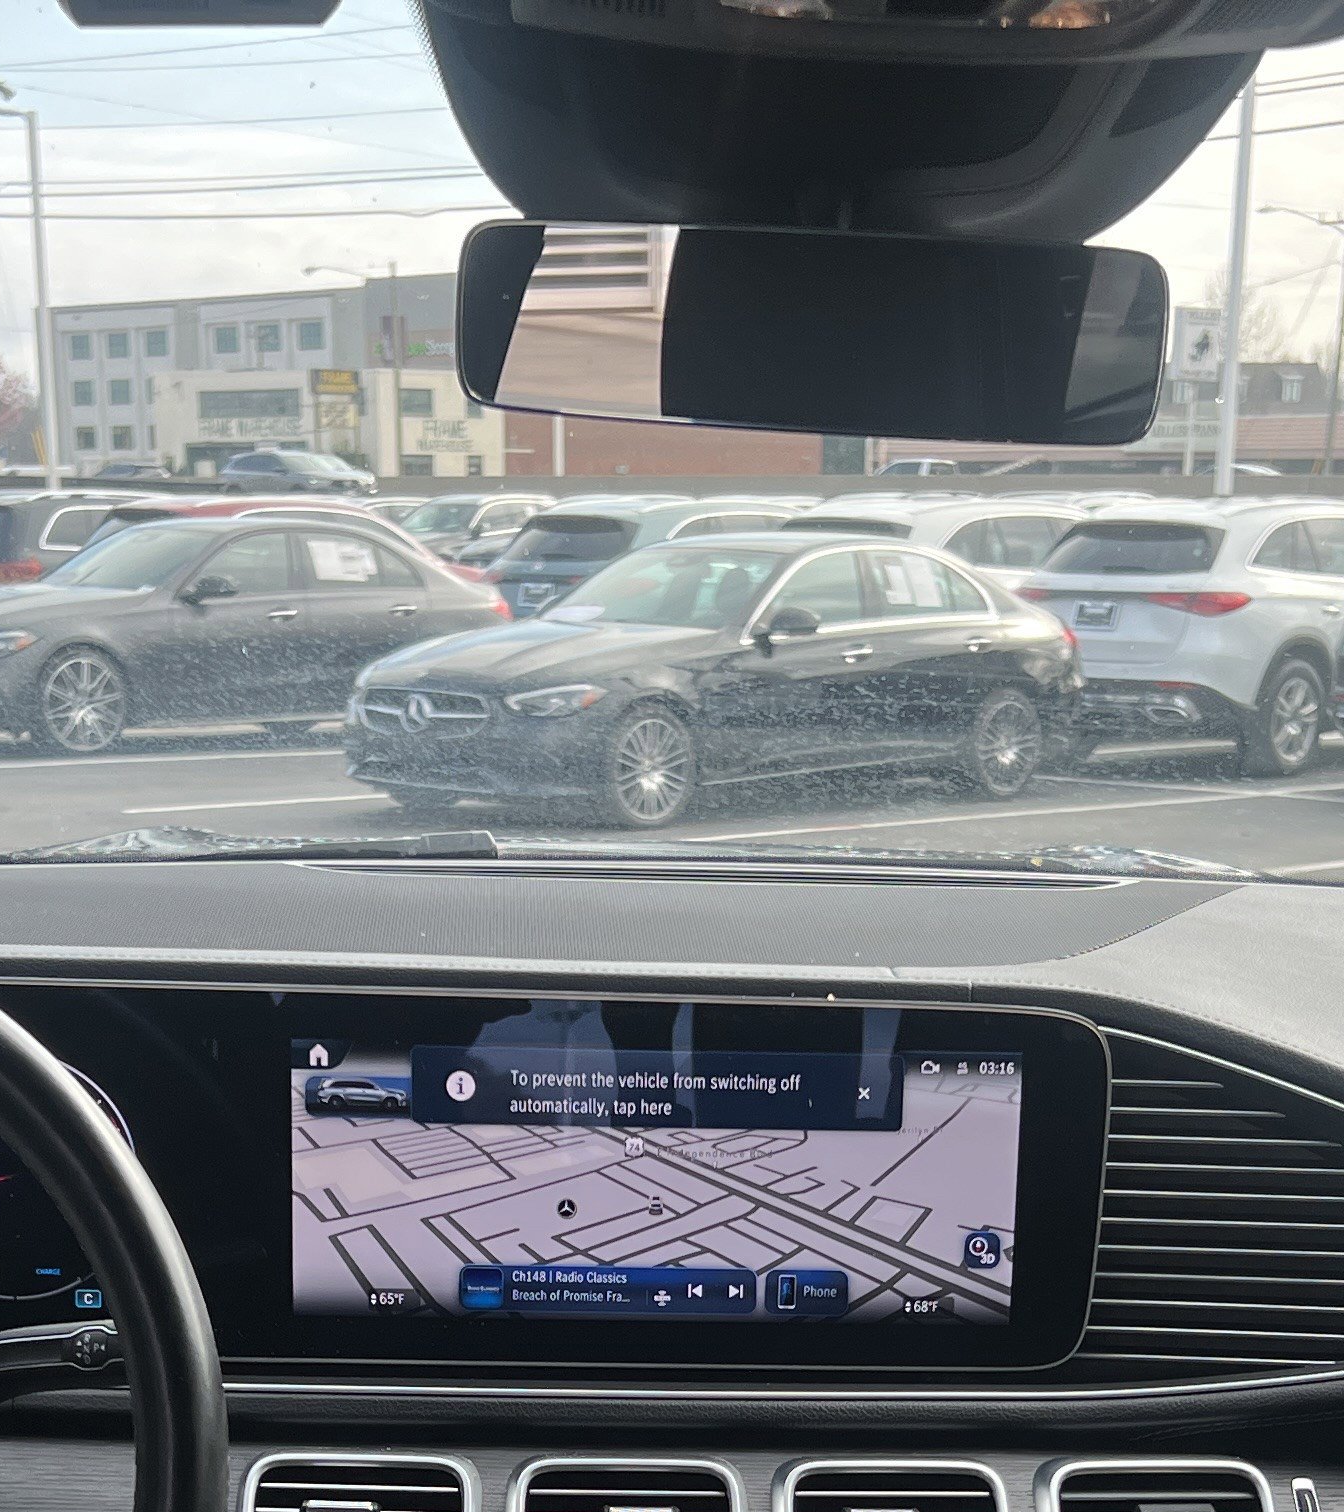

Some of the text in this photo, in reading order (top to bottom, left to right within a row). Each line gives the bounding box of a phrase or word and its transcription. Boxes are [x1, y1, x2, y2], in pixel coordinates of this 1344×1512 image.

[979, 1061, 1015, 1075] 03:16
[510, 1069, 801, 1094] To prevent the vehicle from switching off
[509, 1096, 672, 1119] automatically, tap here
[629, 1142, 641, 1152] 74
[980, 1253, 996, 1265] 3D
[35, 1267, 62, 1276] CHARGE
[512, 1270, 547, 1284] Ch148
[555, 1271, 584, 1284] Radio
[587, 1271, 628, 1285] Classics
[512, 1289, 546, 1302] Breach
[549, 1289, 560, 1302] of
[563, 1289, 604, 1303] Promise
[803, 1285, 838, 1298] Phone
[379, 1292, 405, 1306] 65°F
[913, 1299, 939, 1313] 68°F
